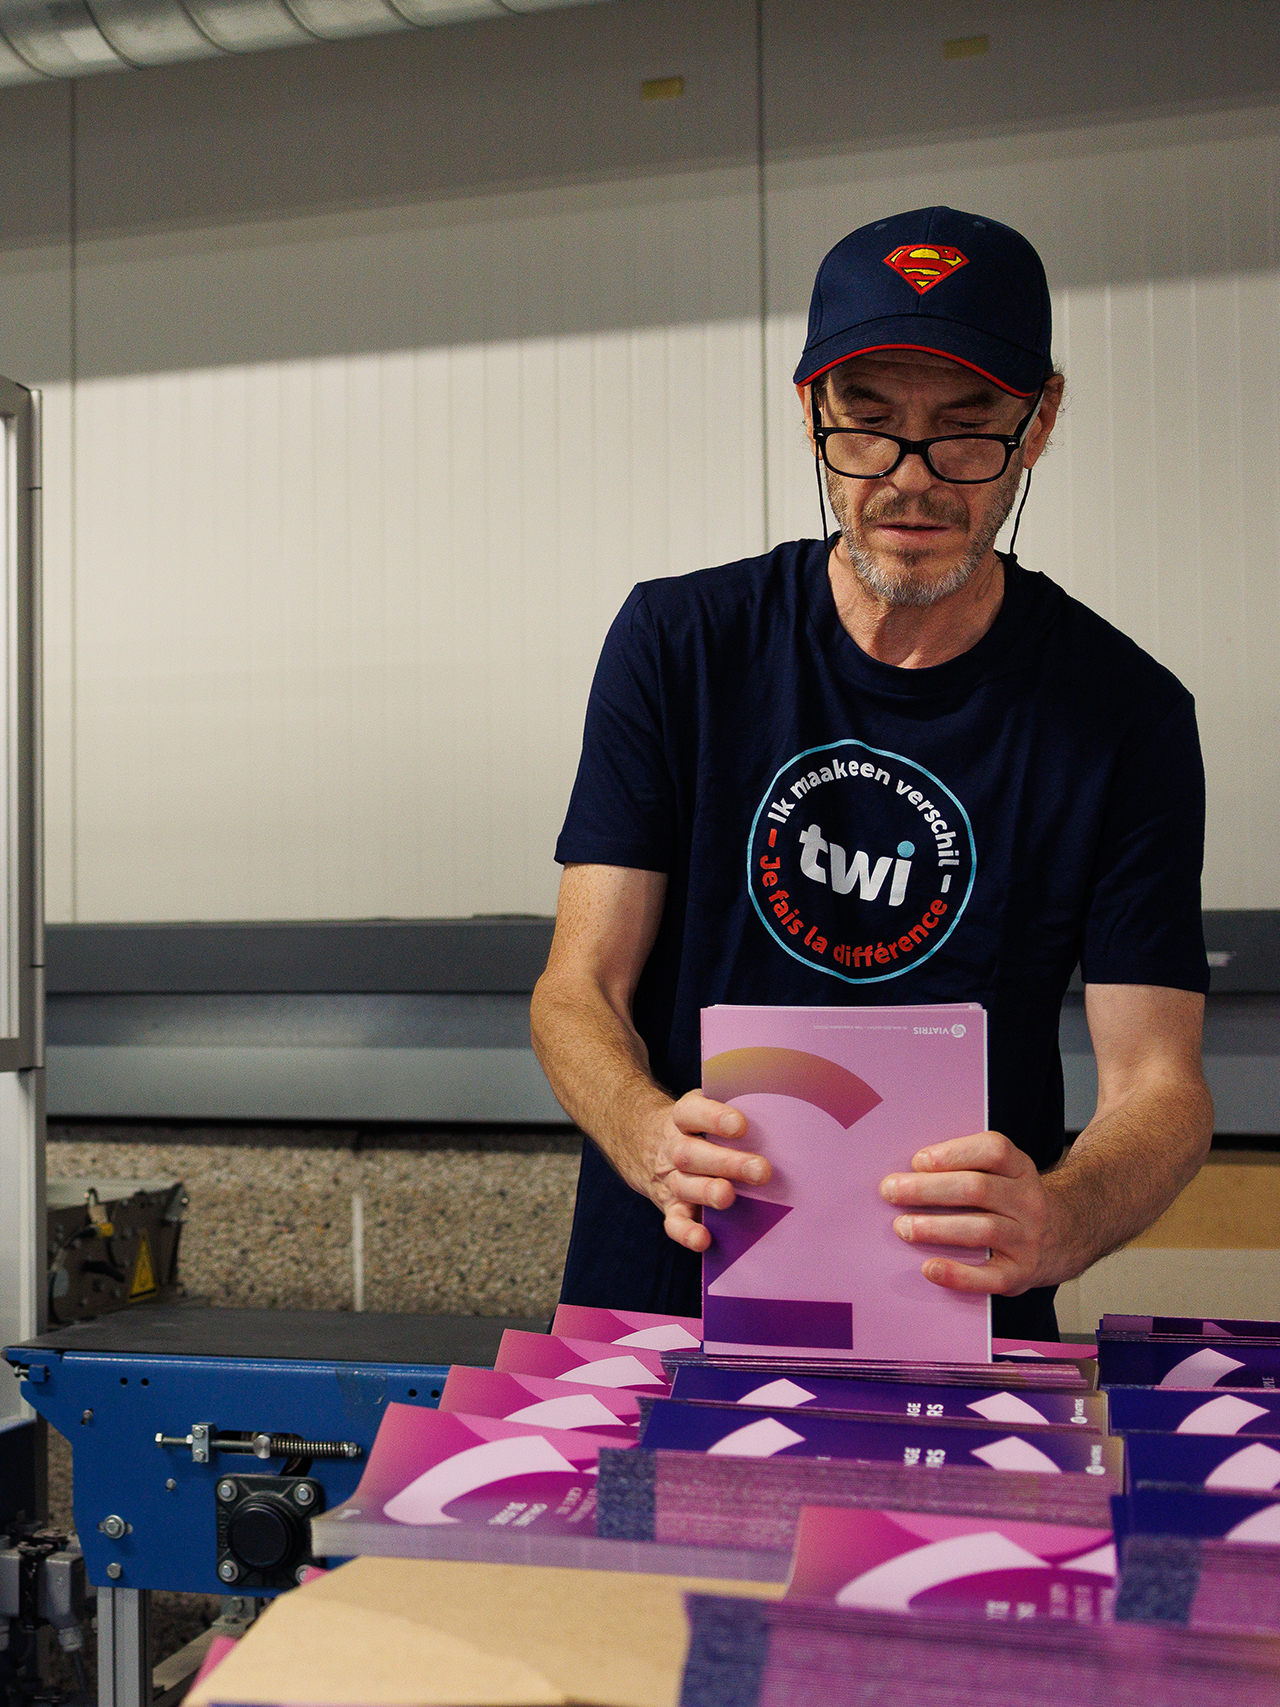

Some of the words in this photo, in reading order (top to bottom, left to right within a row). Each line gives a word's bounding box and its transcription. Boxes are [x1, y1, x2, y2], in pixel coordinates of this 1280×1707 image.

[768, 798, 795, 824] Ik
[895, 779, 960, 867] verschil
[759, 855, 781, 887] Je
[798, 823, 915, 907] twi
[768, 889, 804, 935] fais
[833, 899, 948, 968] différence
[803, 926, 828, 954] la
[913, 1026, 950, 1035] VIATRIS
